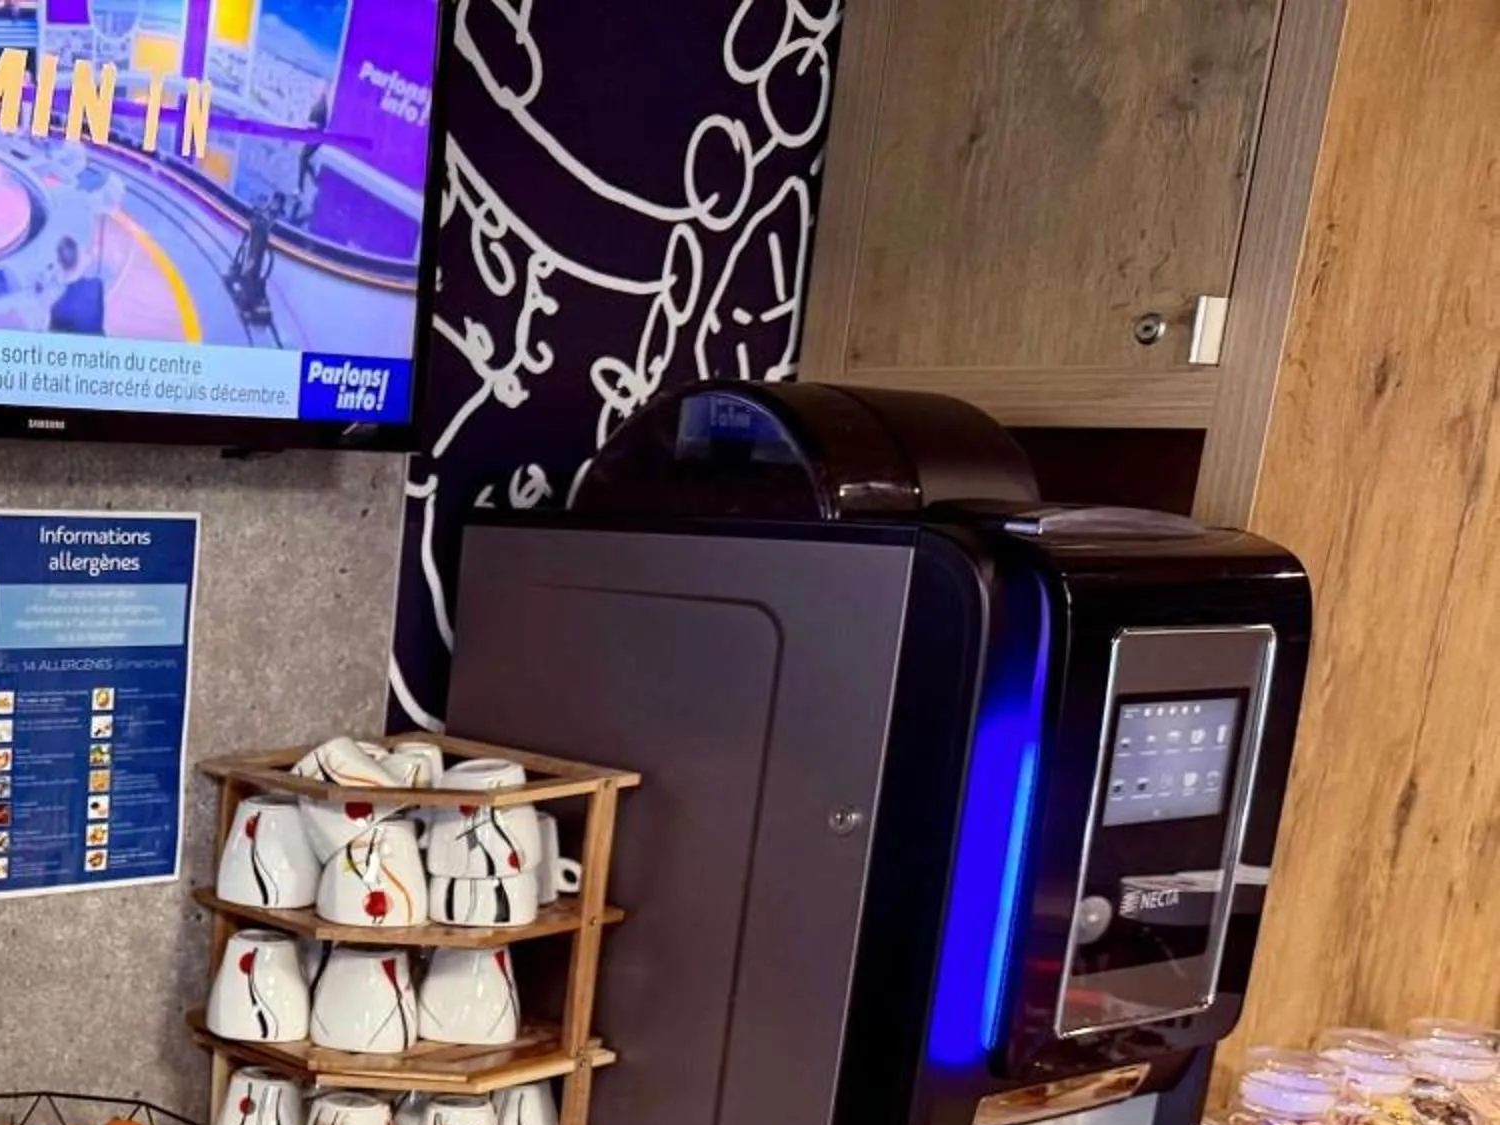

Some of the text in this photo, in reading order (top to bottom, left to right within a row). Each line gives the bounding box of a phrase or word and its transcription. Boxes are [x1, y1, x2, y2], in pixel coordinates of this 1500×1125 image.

[2, 344, 43, 365] sorti
[47, 350, 68, 367] ce
[71, 351, 121, 371] matin
[124, 352, 145, 372] du
[149, 355, 202, 376] centre
[307, 360, 380, 388] Parlons
[19, 371, 27, 391] il
[31, 371, 71, 394] était
[75, 373, 151, 399] incarcéré
[154, 380, 208, 403] depuis
[39, 525, 152, 545] Informations
[49, 550, 141, 577] allergènes
